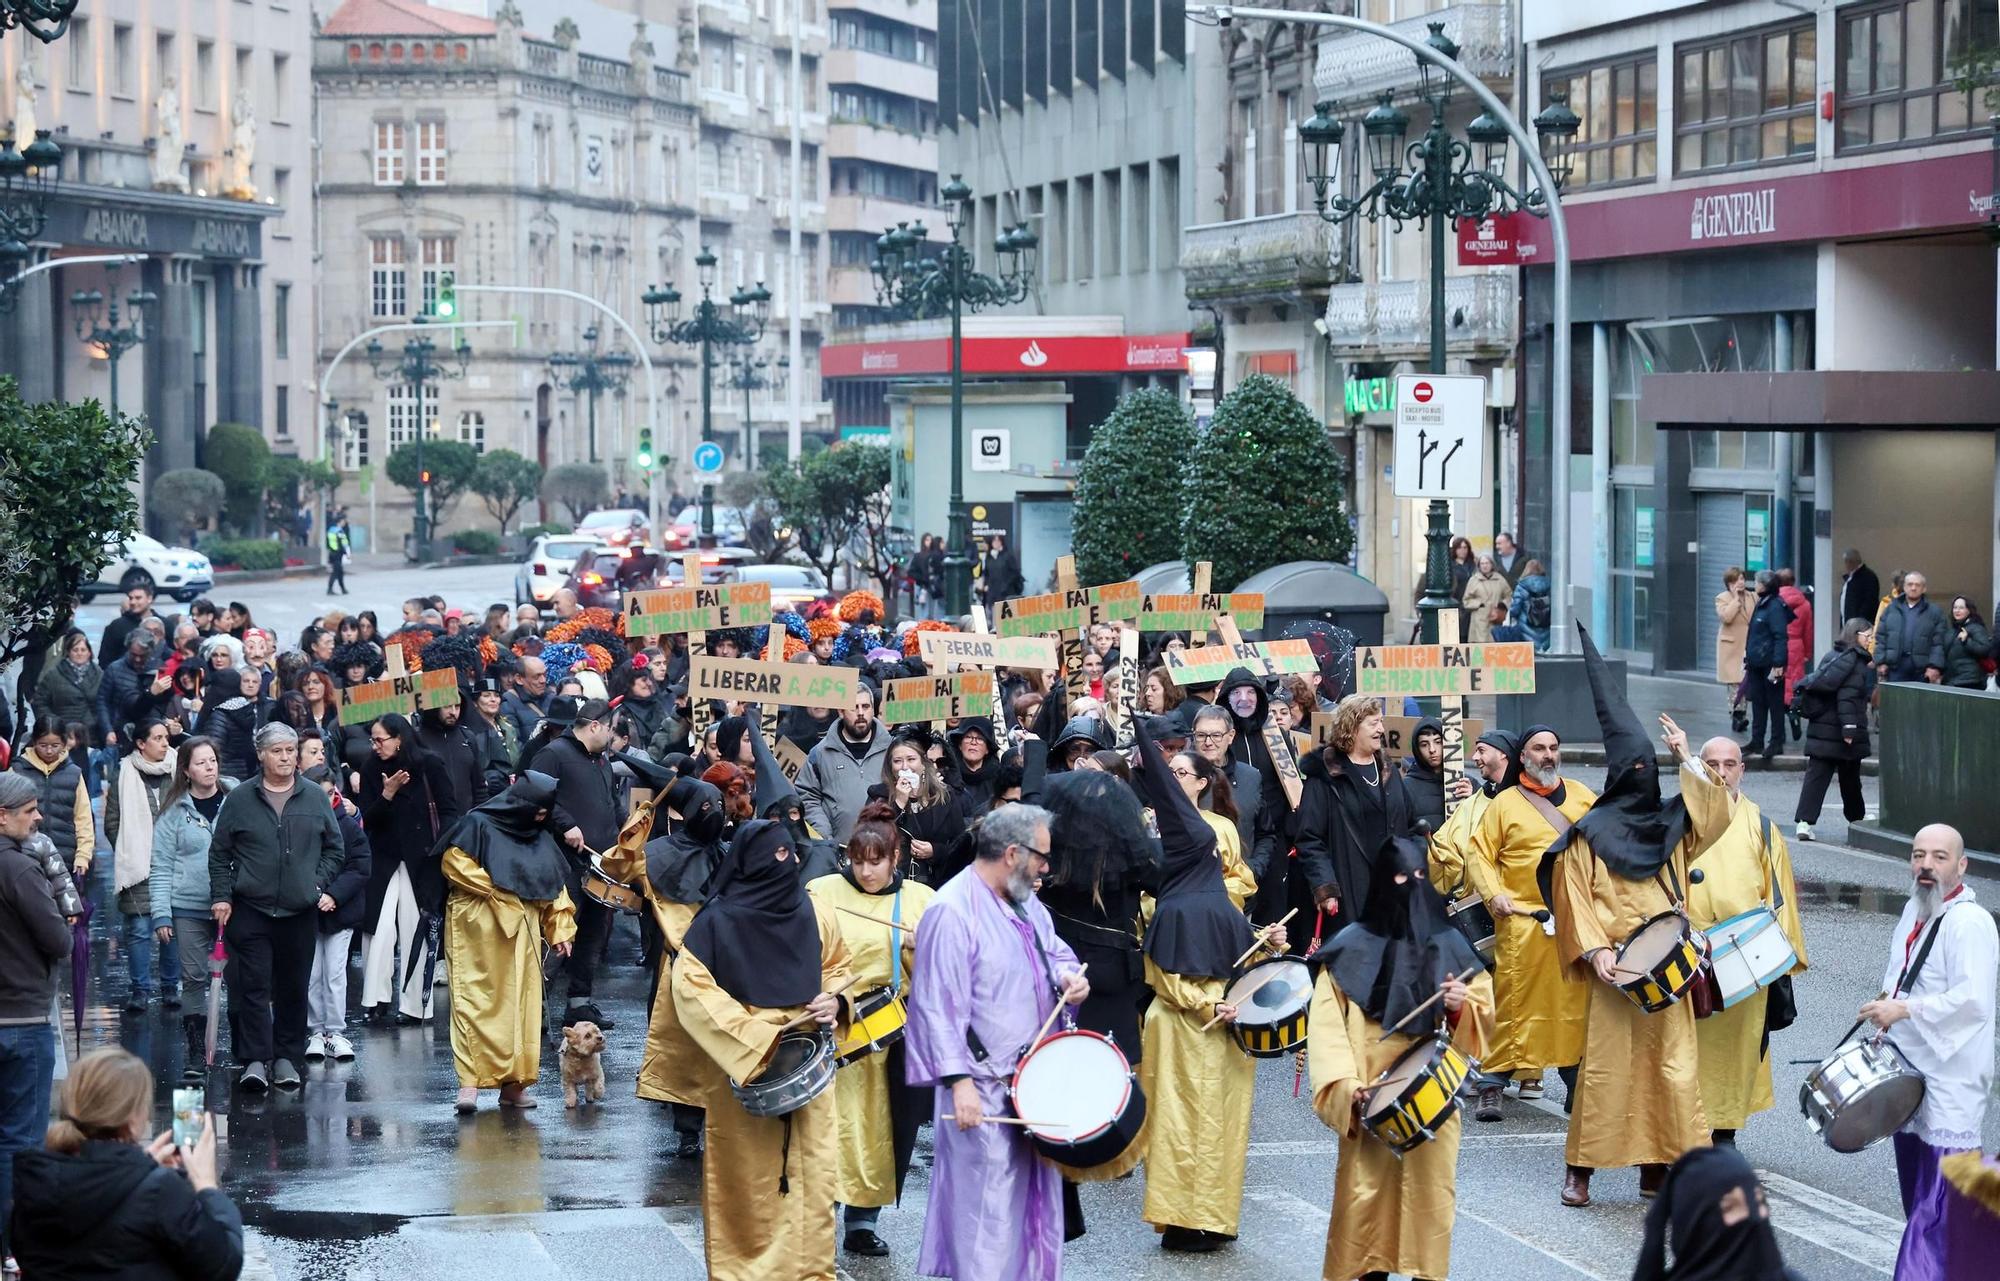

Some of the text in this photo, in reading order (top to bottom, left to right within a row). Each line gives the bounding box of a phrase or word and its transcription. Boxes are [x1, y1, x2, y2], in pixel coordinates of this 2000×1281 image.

[1703, 188, 1776, 238] GENERALI
[84, 209, 149, 248] ABANCA
[192, 219, 250, 254] ABANCA
[1465, 240, 1508, 251] GENERALI
[630, 597, 642, 616] A
[696, 589, 719, 608] FAI
[1001, 601, 1012, 619] A
[1066, 588, 1090, 609] FAI
[1142, 595, 1153, 612] A
[1201, 593, 1221, 610] FAI
[630, 608, 712, 635] BEMBRIVE
[720, 606, 730, 626] E
[1090, 606, 1100, 625] E
[926, 638, 994, 658] LBERAR
[1168, 650, 1184, 668] A
[1234, 642, 1260, 660] FAI
[1362, 648, 1376, 668] A
[1442, 646, 1470, 668] FAI
[1262, 658, 1278, 676] E
[342, 688, 352, 706] A
[394, 676, 414, 696] FAI
[700, 668, 782, 694] LIBERAR
[788, 676, 801, 696] A
[886, 682, 895, 701] A
[935, 678, 952, 697] FAI
[1362, 668, 1460, 693] BEMBRIVE
[1470, 669, 1482, 692] E
[414, 692, 423, 710] E
[952, 697, 959, 716] E
